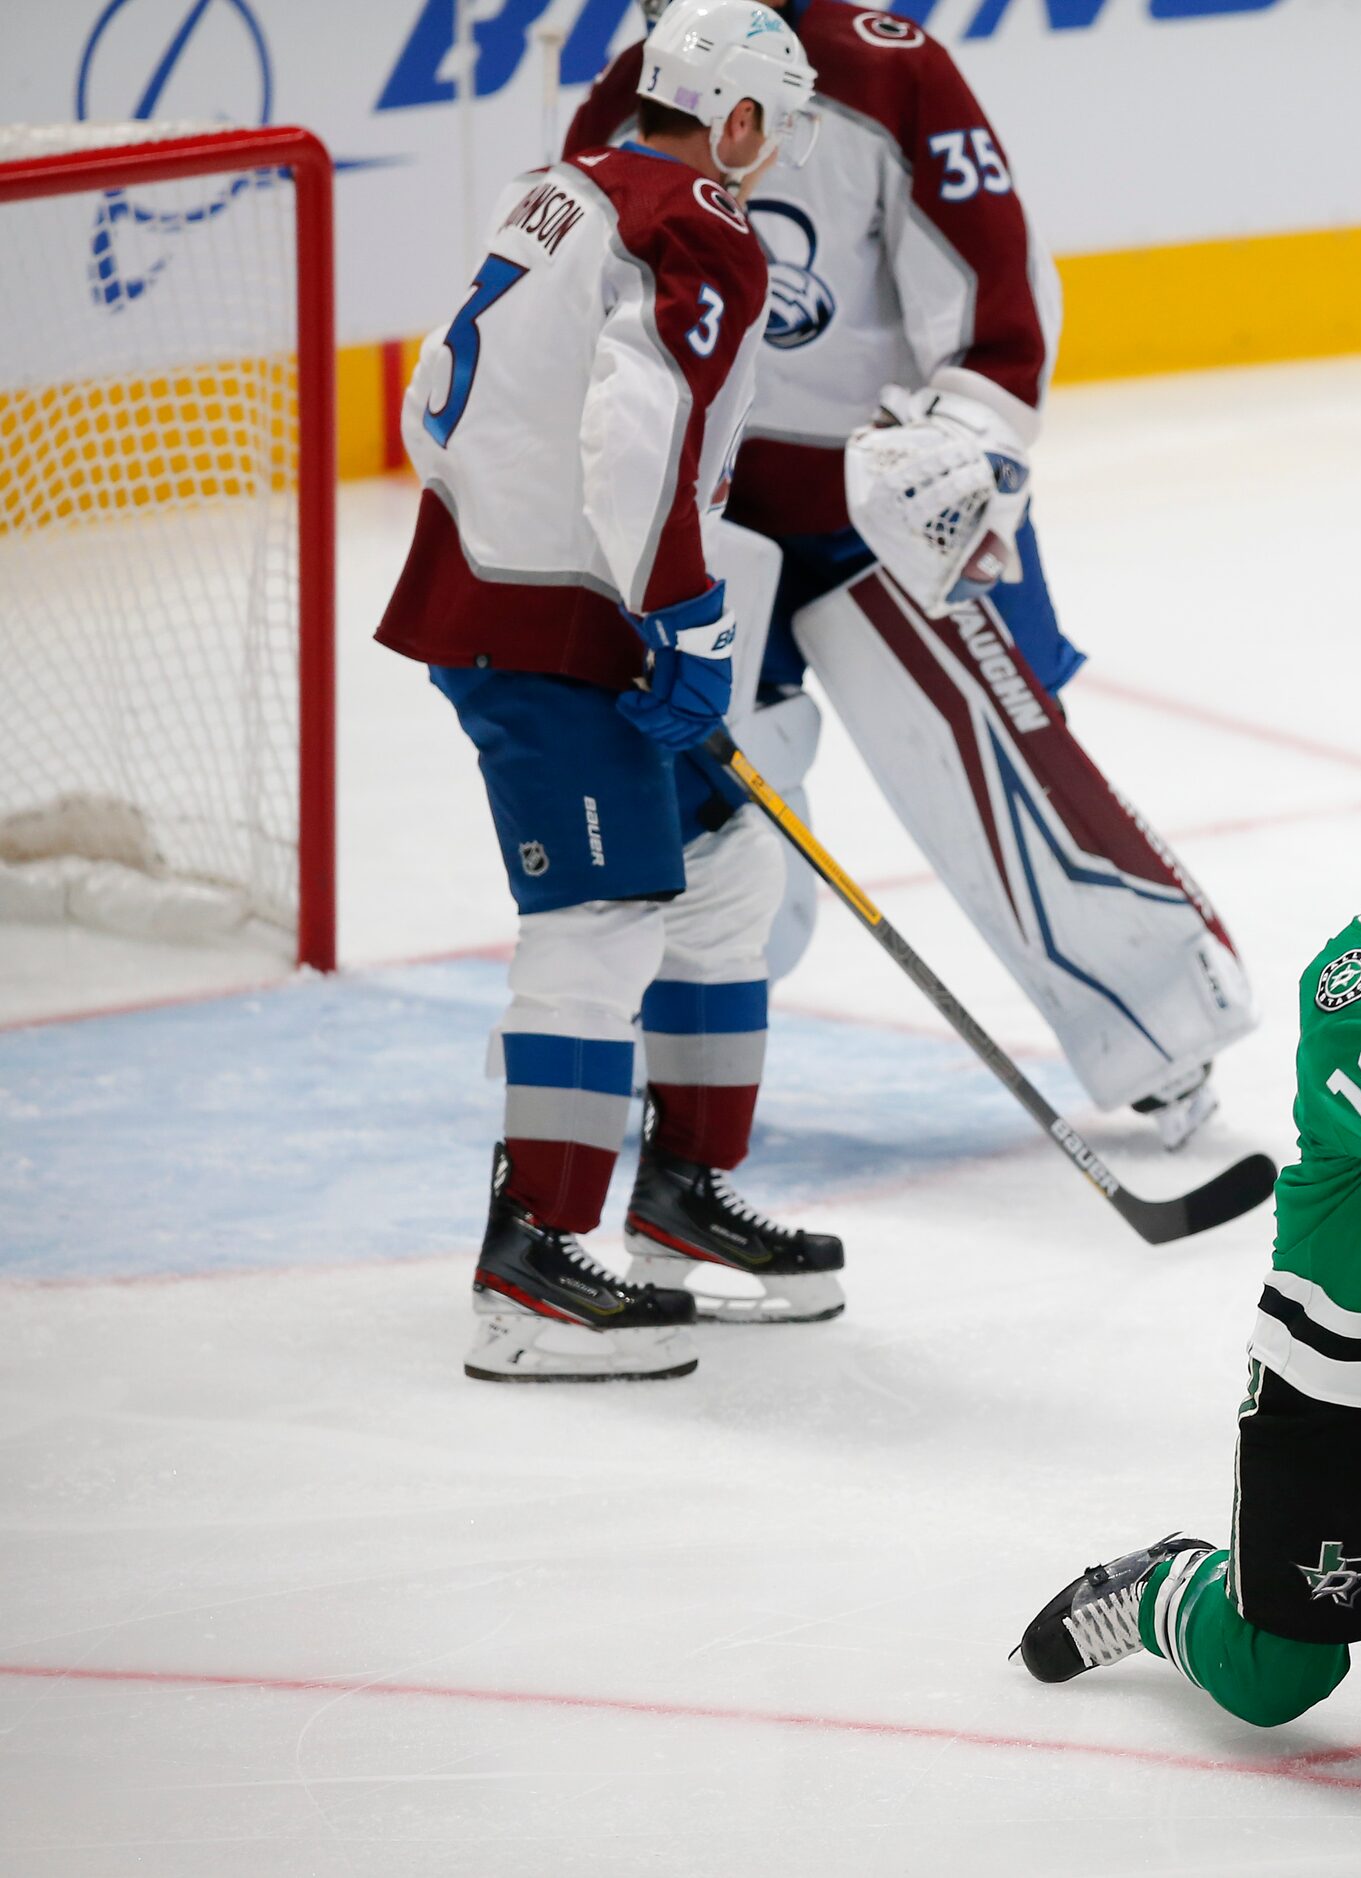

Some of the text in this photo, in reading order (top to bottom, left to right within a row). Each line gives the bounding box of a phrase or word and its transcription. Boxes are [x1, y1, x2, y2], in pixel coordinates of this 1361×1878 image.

[648, 66, 660, 92] 3
[926, 128, 1012, 203] 35
[422, 252, 530, 450] 3
[686, 283, 724, 358] 3
